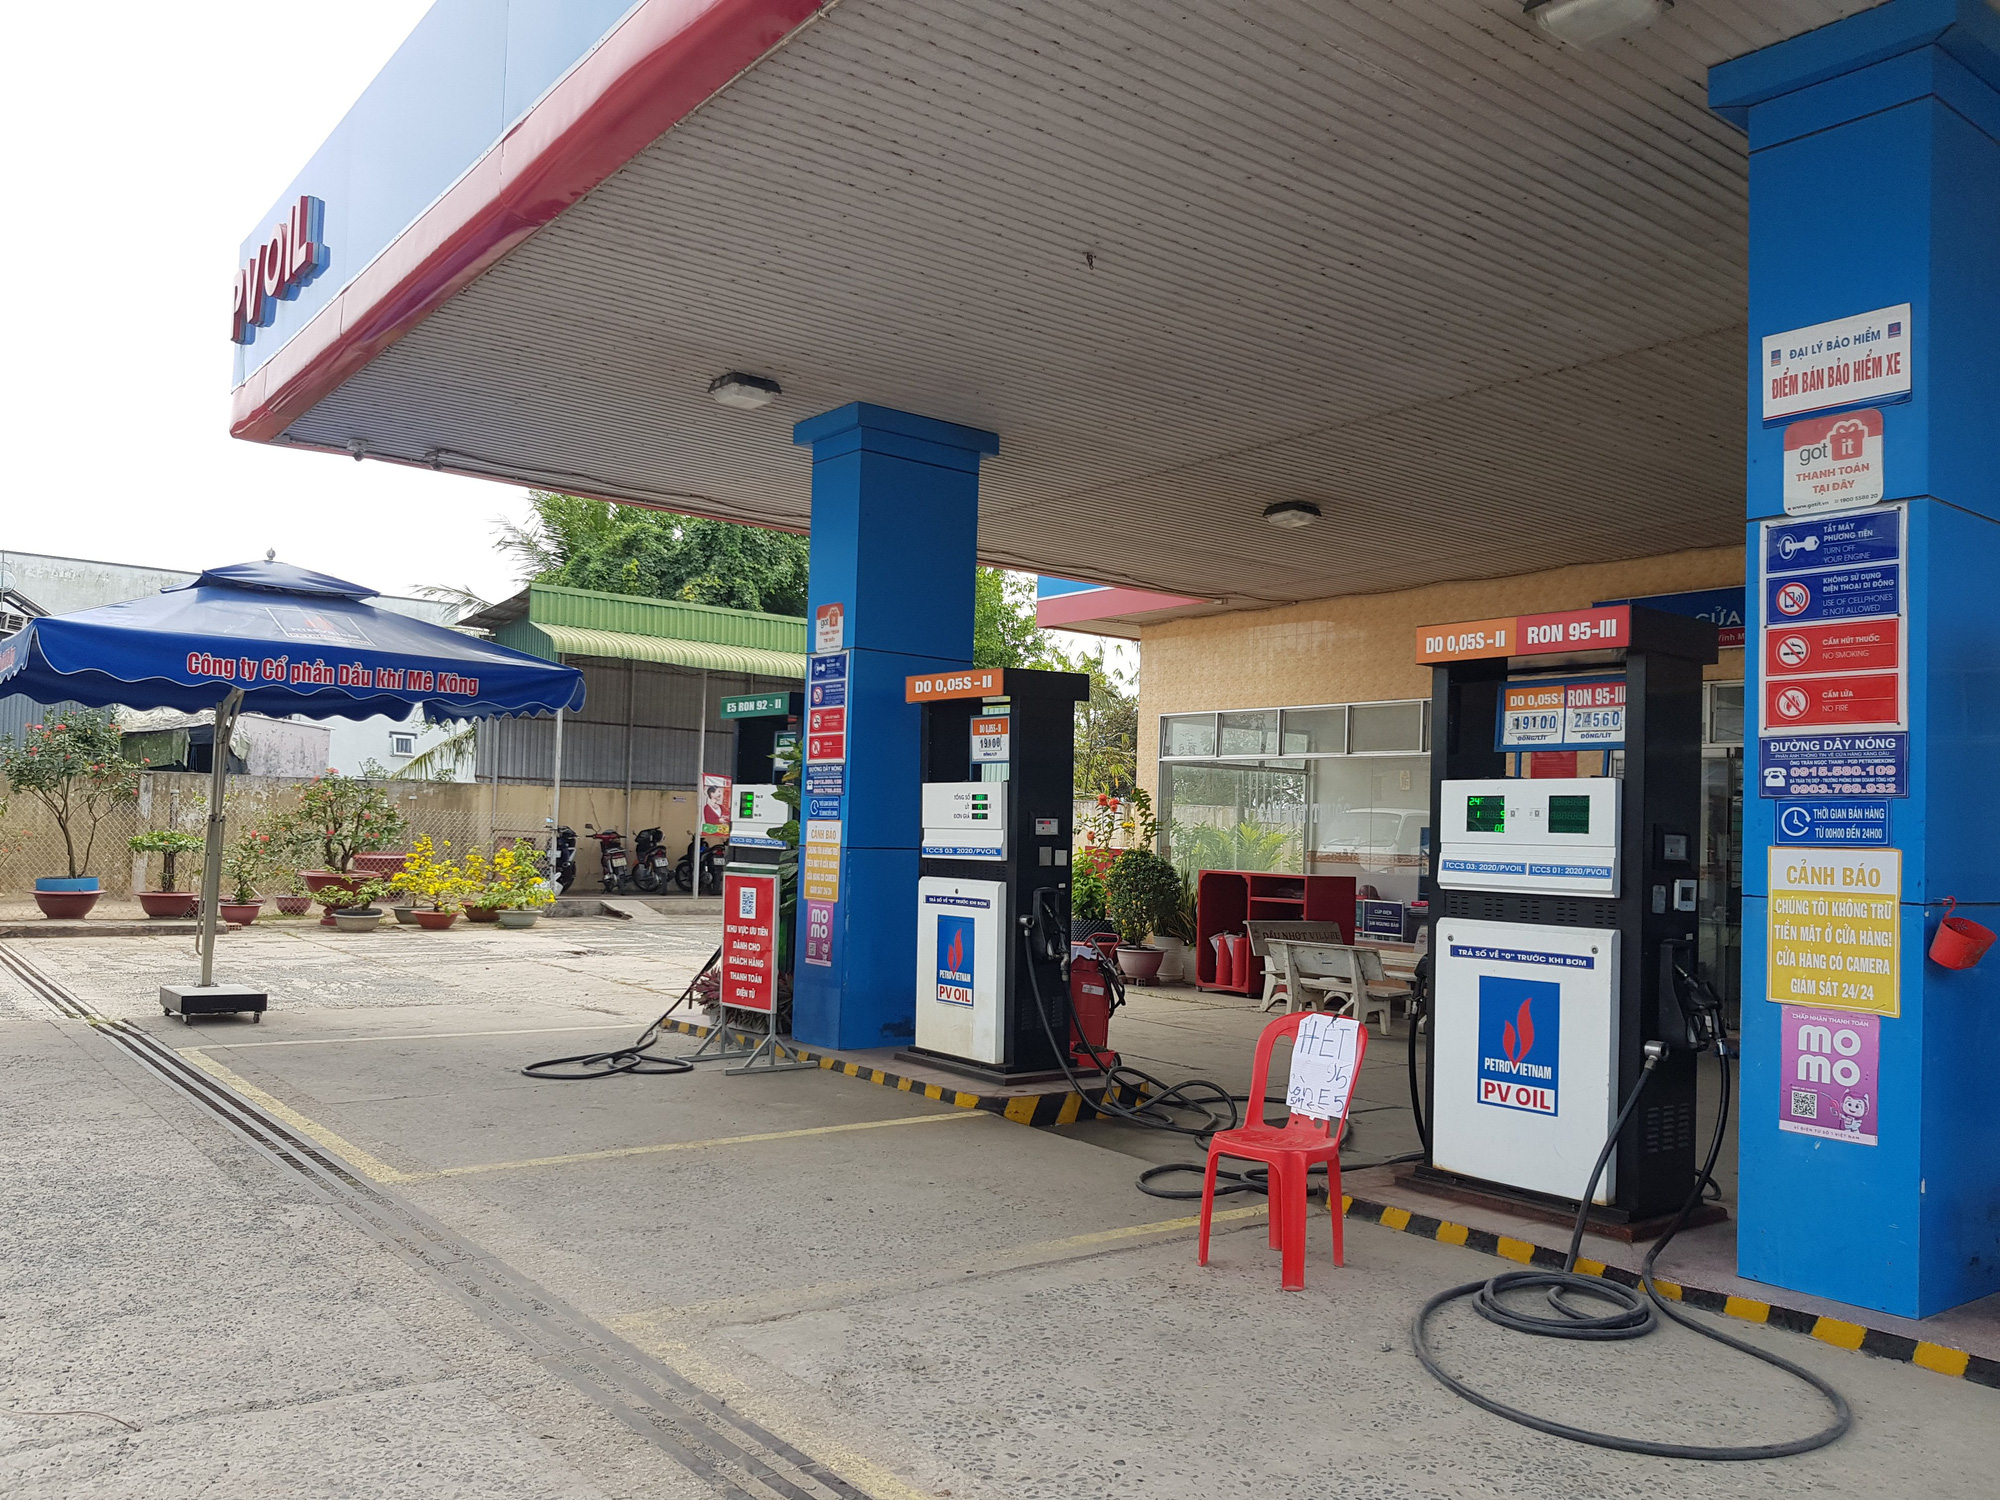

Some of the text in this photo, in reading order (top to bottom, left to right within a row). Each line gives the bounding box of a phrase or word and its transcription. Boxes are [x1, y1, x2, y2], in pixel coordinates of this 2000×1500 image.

[231, 195, 318, 342] PVOIL
[1790, 327, 1880, 360] ĐẠI LÝ BẢO HIỂM
[1772, 349, 1901, 399] ĐIỂM BÁN BẢO HIỂM XE
[1800, 438, 1854, 466] got it
[1796, 463, 1869, 482] THANH TOÁN
[1812, 479, 1855, 495] TẠI ĐÂY
[1824, 524, 1836, 533] TẮT
[1824, 533, 1855, 542] PHƯƠNG
[1823, 574, 1849, 584] KHÔNG
[1823, 584, 1838, 593] ĐIỆN
[1527, 619, 1617, 644] RON 95-III
[1823, 633, 1880, 645] CẤM HÚT THUỐC
[1426, 637, 1443, 653] DO
[187, 652, 479, 697] Công ty Cổ phần Dầu khí Mê Kông
[915, 680, 931, 693] DO
[1511, 696, 1524, 706] DO
[1568, 689, 1592, 706] RON
[1822, 690, 1838, 699] CẤM
[727, 703, 736, 712] E5
[738, 701, 754, 711] RON
[756, 701, 767, 710] 92
[1575, 711, 1620, 728] 24560
[1770, 737, 1896, 752] ĐƯỜNG DÂY NÓNG
[1790, 765, 1896, 776] 0915.580.109
[1813, 807, 1885, 819] THỜI GIAN BÁN HÀNG
[1815, 824, 1882, 838] TỪ 00H00 ĐẾN 24H00
[1466, 862, 1477, 871] 03:
[1479, 863, 1522, 872] 2020/PVOIL
[1566, 867, 1608, 876] 2020/PVOIL
[1787, 859, 1881, 887] CẢNH BÁO
[1776, 897, 1892, 919] CHÚNG TÔI KHÔNG TRỮ
[738, 926, 748, 936] VỰC
[758, 926, 768, 936] TIÊN
[1775, 919, 1797, 940] TIỀN
[1800, 924, 1822, 946] MẶT
[1835, 924, 1856, 945] CỬA
[1860, 926, 1892, 947] HÀNG!
[733, 941, 747, 950] DÀNH
[729, 956, 764, 968] KHÁCH HÀNG
[1458, 948, 1473, 957] TRẢ
[1475, 948, 1487, 958] SỐ
[1518, 953, 1546, 963] TRƯỚC
[1776, 946, 1890, 975] CỬA HÀNG CÓ CAMERA
[730, 972, 762, 983] THANH TOÁN
[940, 970, 971, 982] PETROVIETNAM
[736, 988, 748, 999] ĐIỆN
[940, 986, 970, 1002] PV OIL
[1791, 976, 1874, 1000] GIÁM SÁT 24/24
[1484, 1057, 1552, 1080] PETROVIETNAM
[1318, 1088, 1346, 1112] E5
[1484, 1081, 1551, 1110] PV OIL
